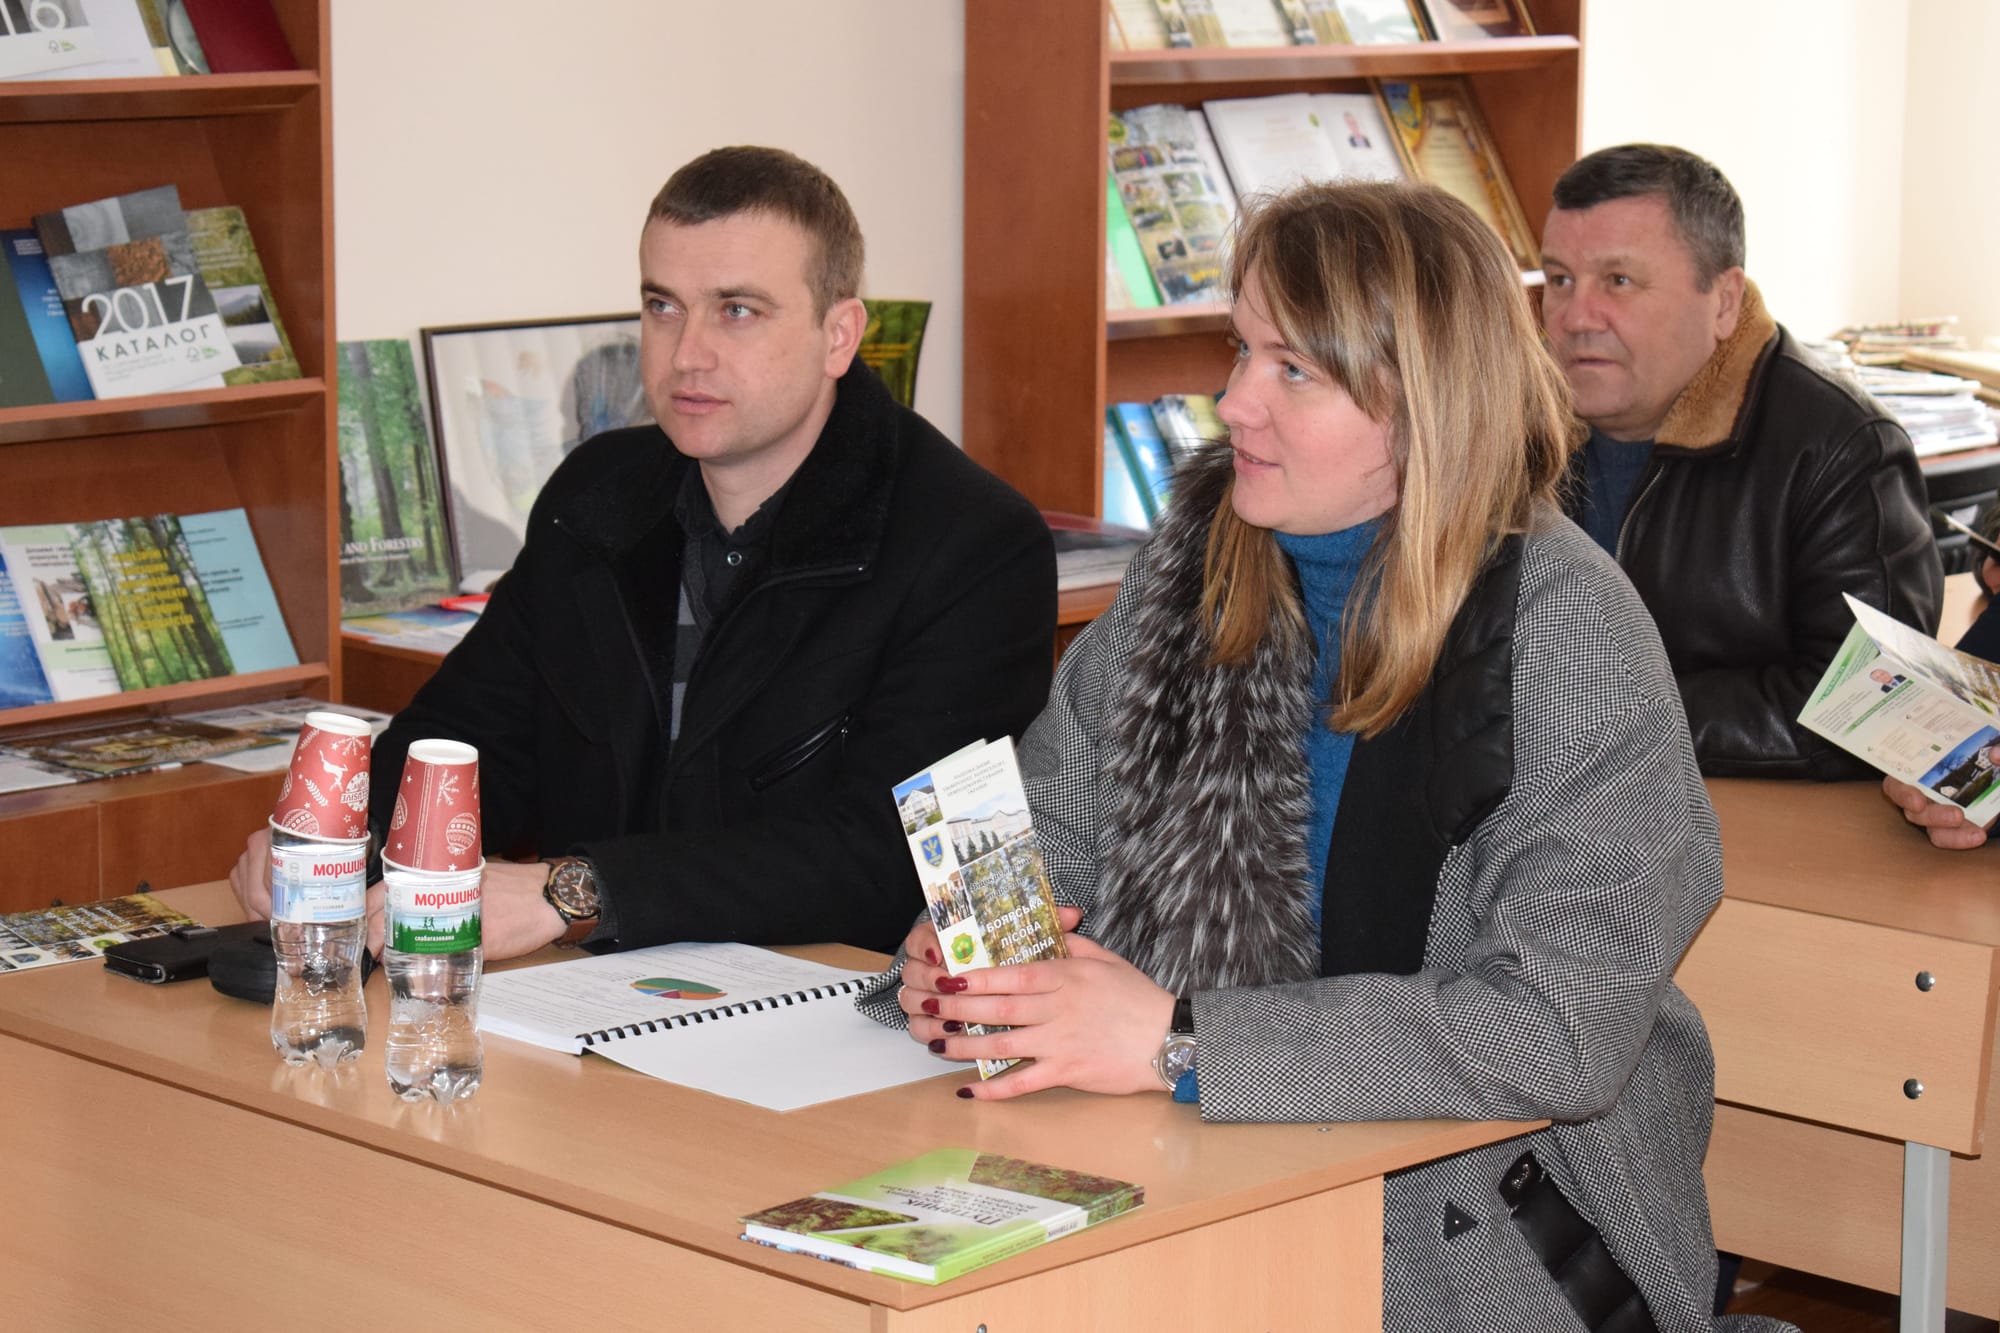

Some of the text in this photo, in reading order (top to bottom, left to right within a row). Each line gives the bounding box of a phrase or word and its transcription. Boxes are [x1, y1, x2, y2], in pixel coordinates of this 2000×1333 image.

[81, 273, 194, 341] 2017
[95, 323, 209, 362] КАТАЛОГ
[986, 897, 1044, 933] БОЯРСЬКА
[1001, 921, 1042, 949] ЛІСОВА
